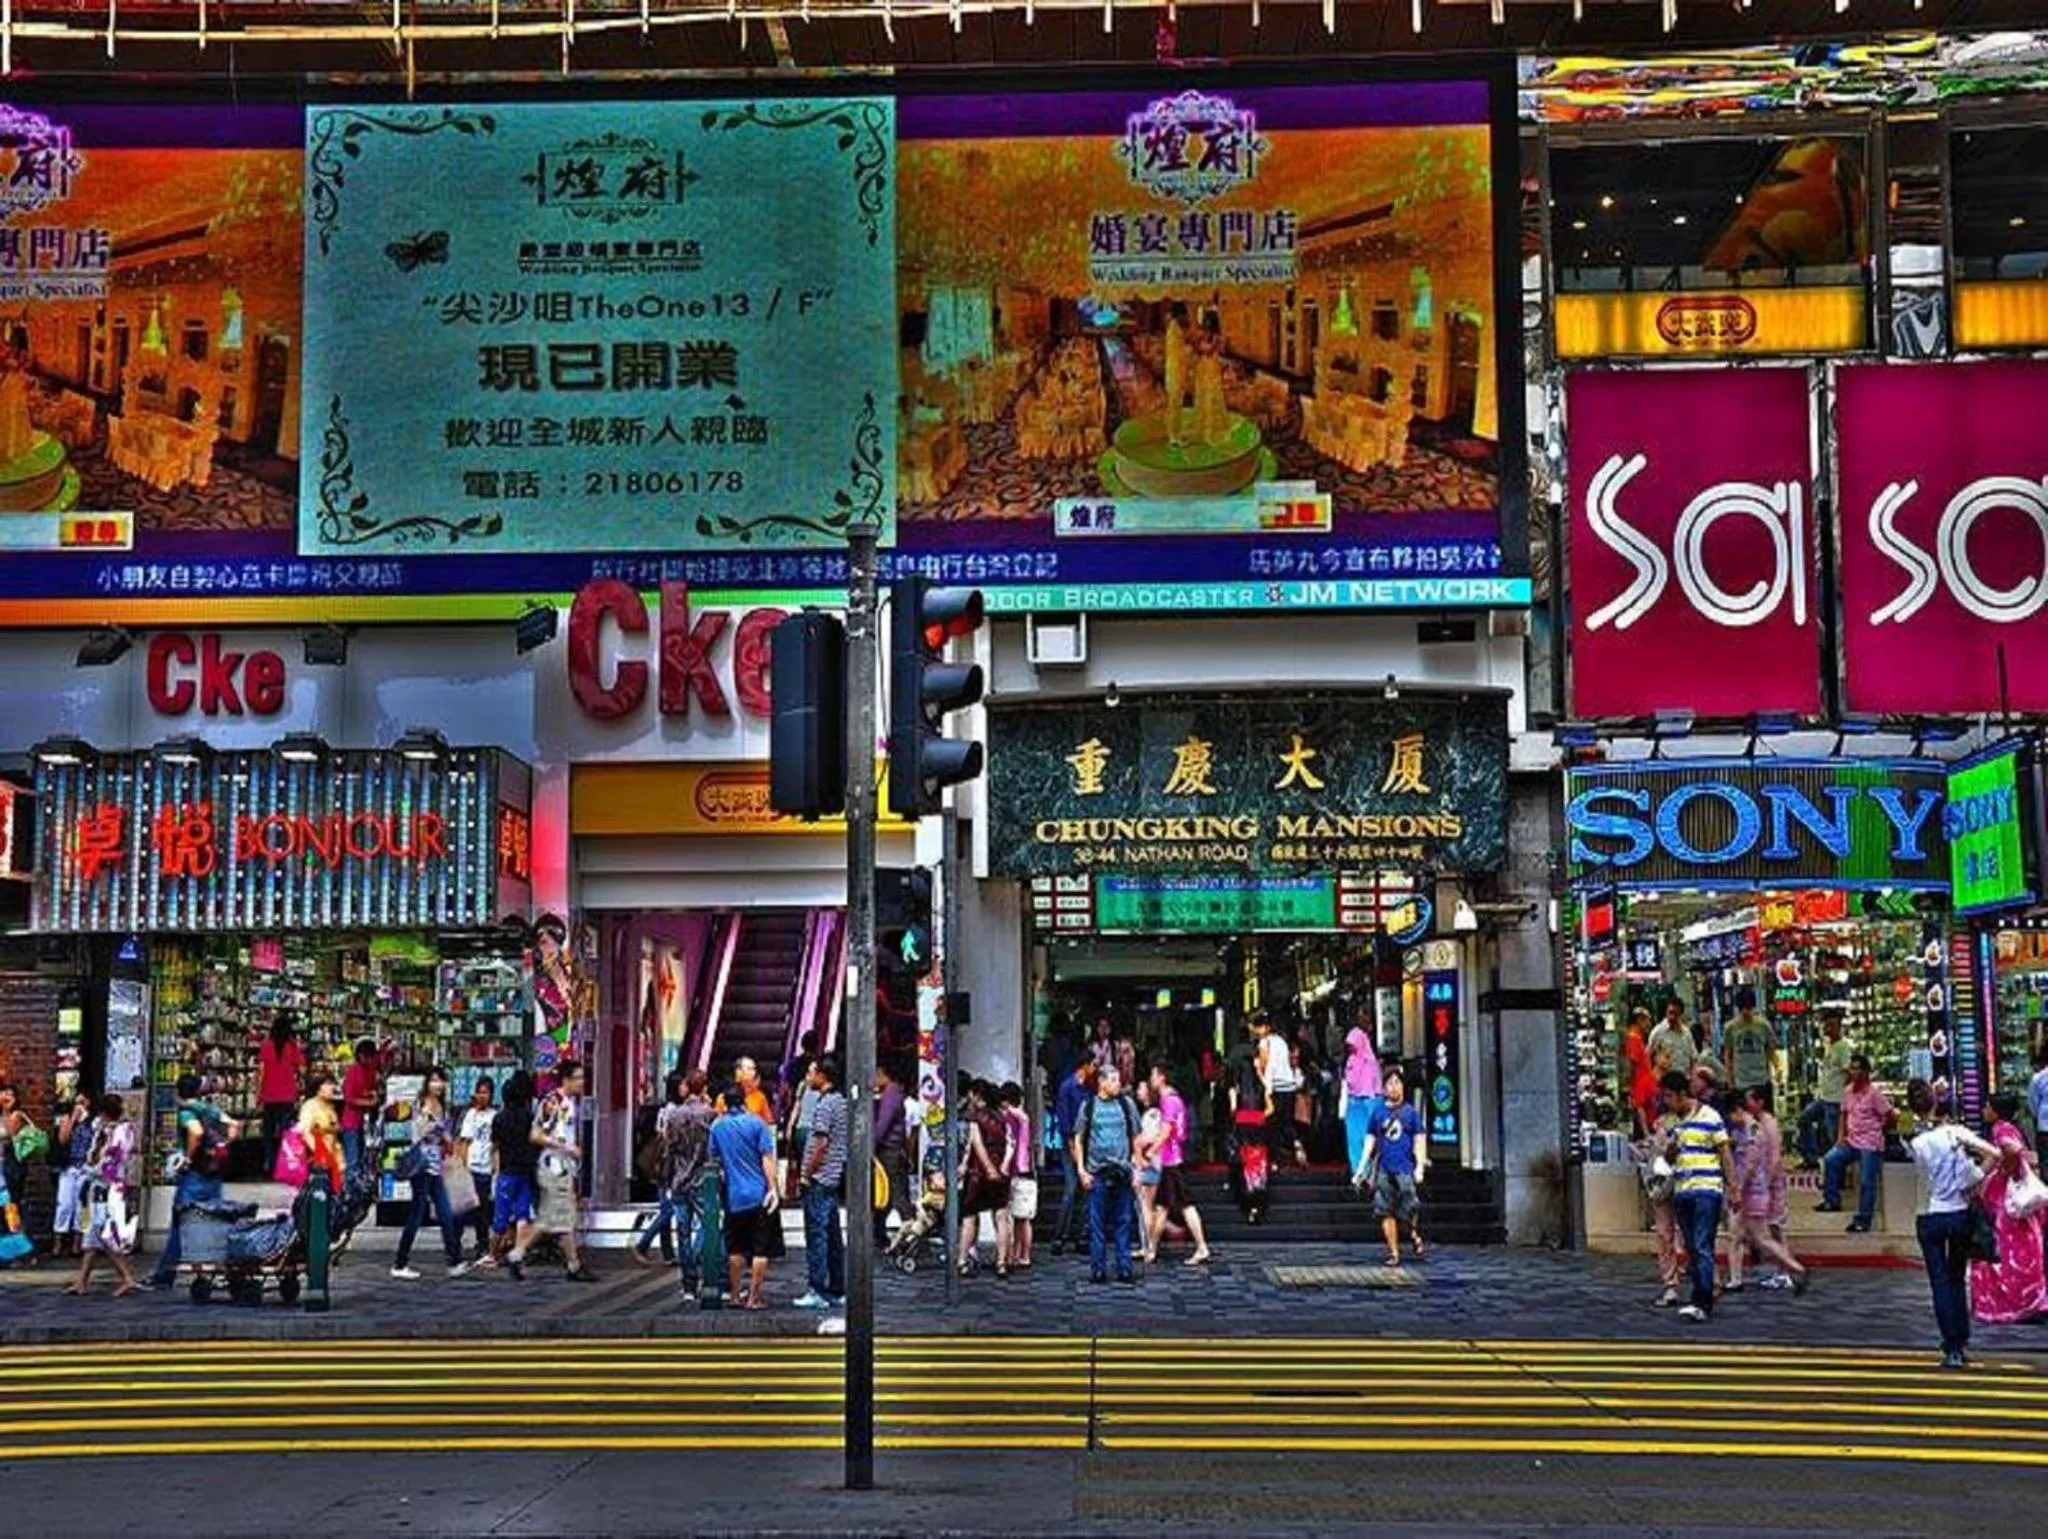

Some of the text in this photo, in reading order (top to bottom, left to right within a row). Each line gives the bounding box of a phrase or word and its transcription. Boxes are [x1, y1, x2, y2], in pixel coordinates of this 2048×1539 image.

[1143, 122, 1241, 173] 煌府
[1092, 209, 1297, 255] 婚宴專門店
[478, 340, 739, 392] 現已開業
[444, 416, 771, 449] 歡迎全城新人親臨
[1063, 588, 1255, 608] BROADCASTER
[1290, 582, 1336, 605] JM
[1350, 578, 1512, 603] NETWORK
[147, 633, 285, 716] Cke
[1036, 812, 1461, 842] CHUNGKING MANSIONS
[1568, 781, 1942, 867] SONY
[1942, 784, 2014, 842] SONY
[236, 812, 446, 870] BONJOUR
[1124, 846, 1193, 863] NATHAN
[1199, 845, 1249, 861] ROAD
